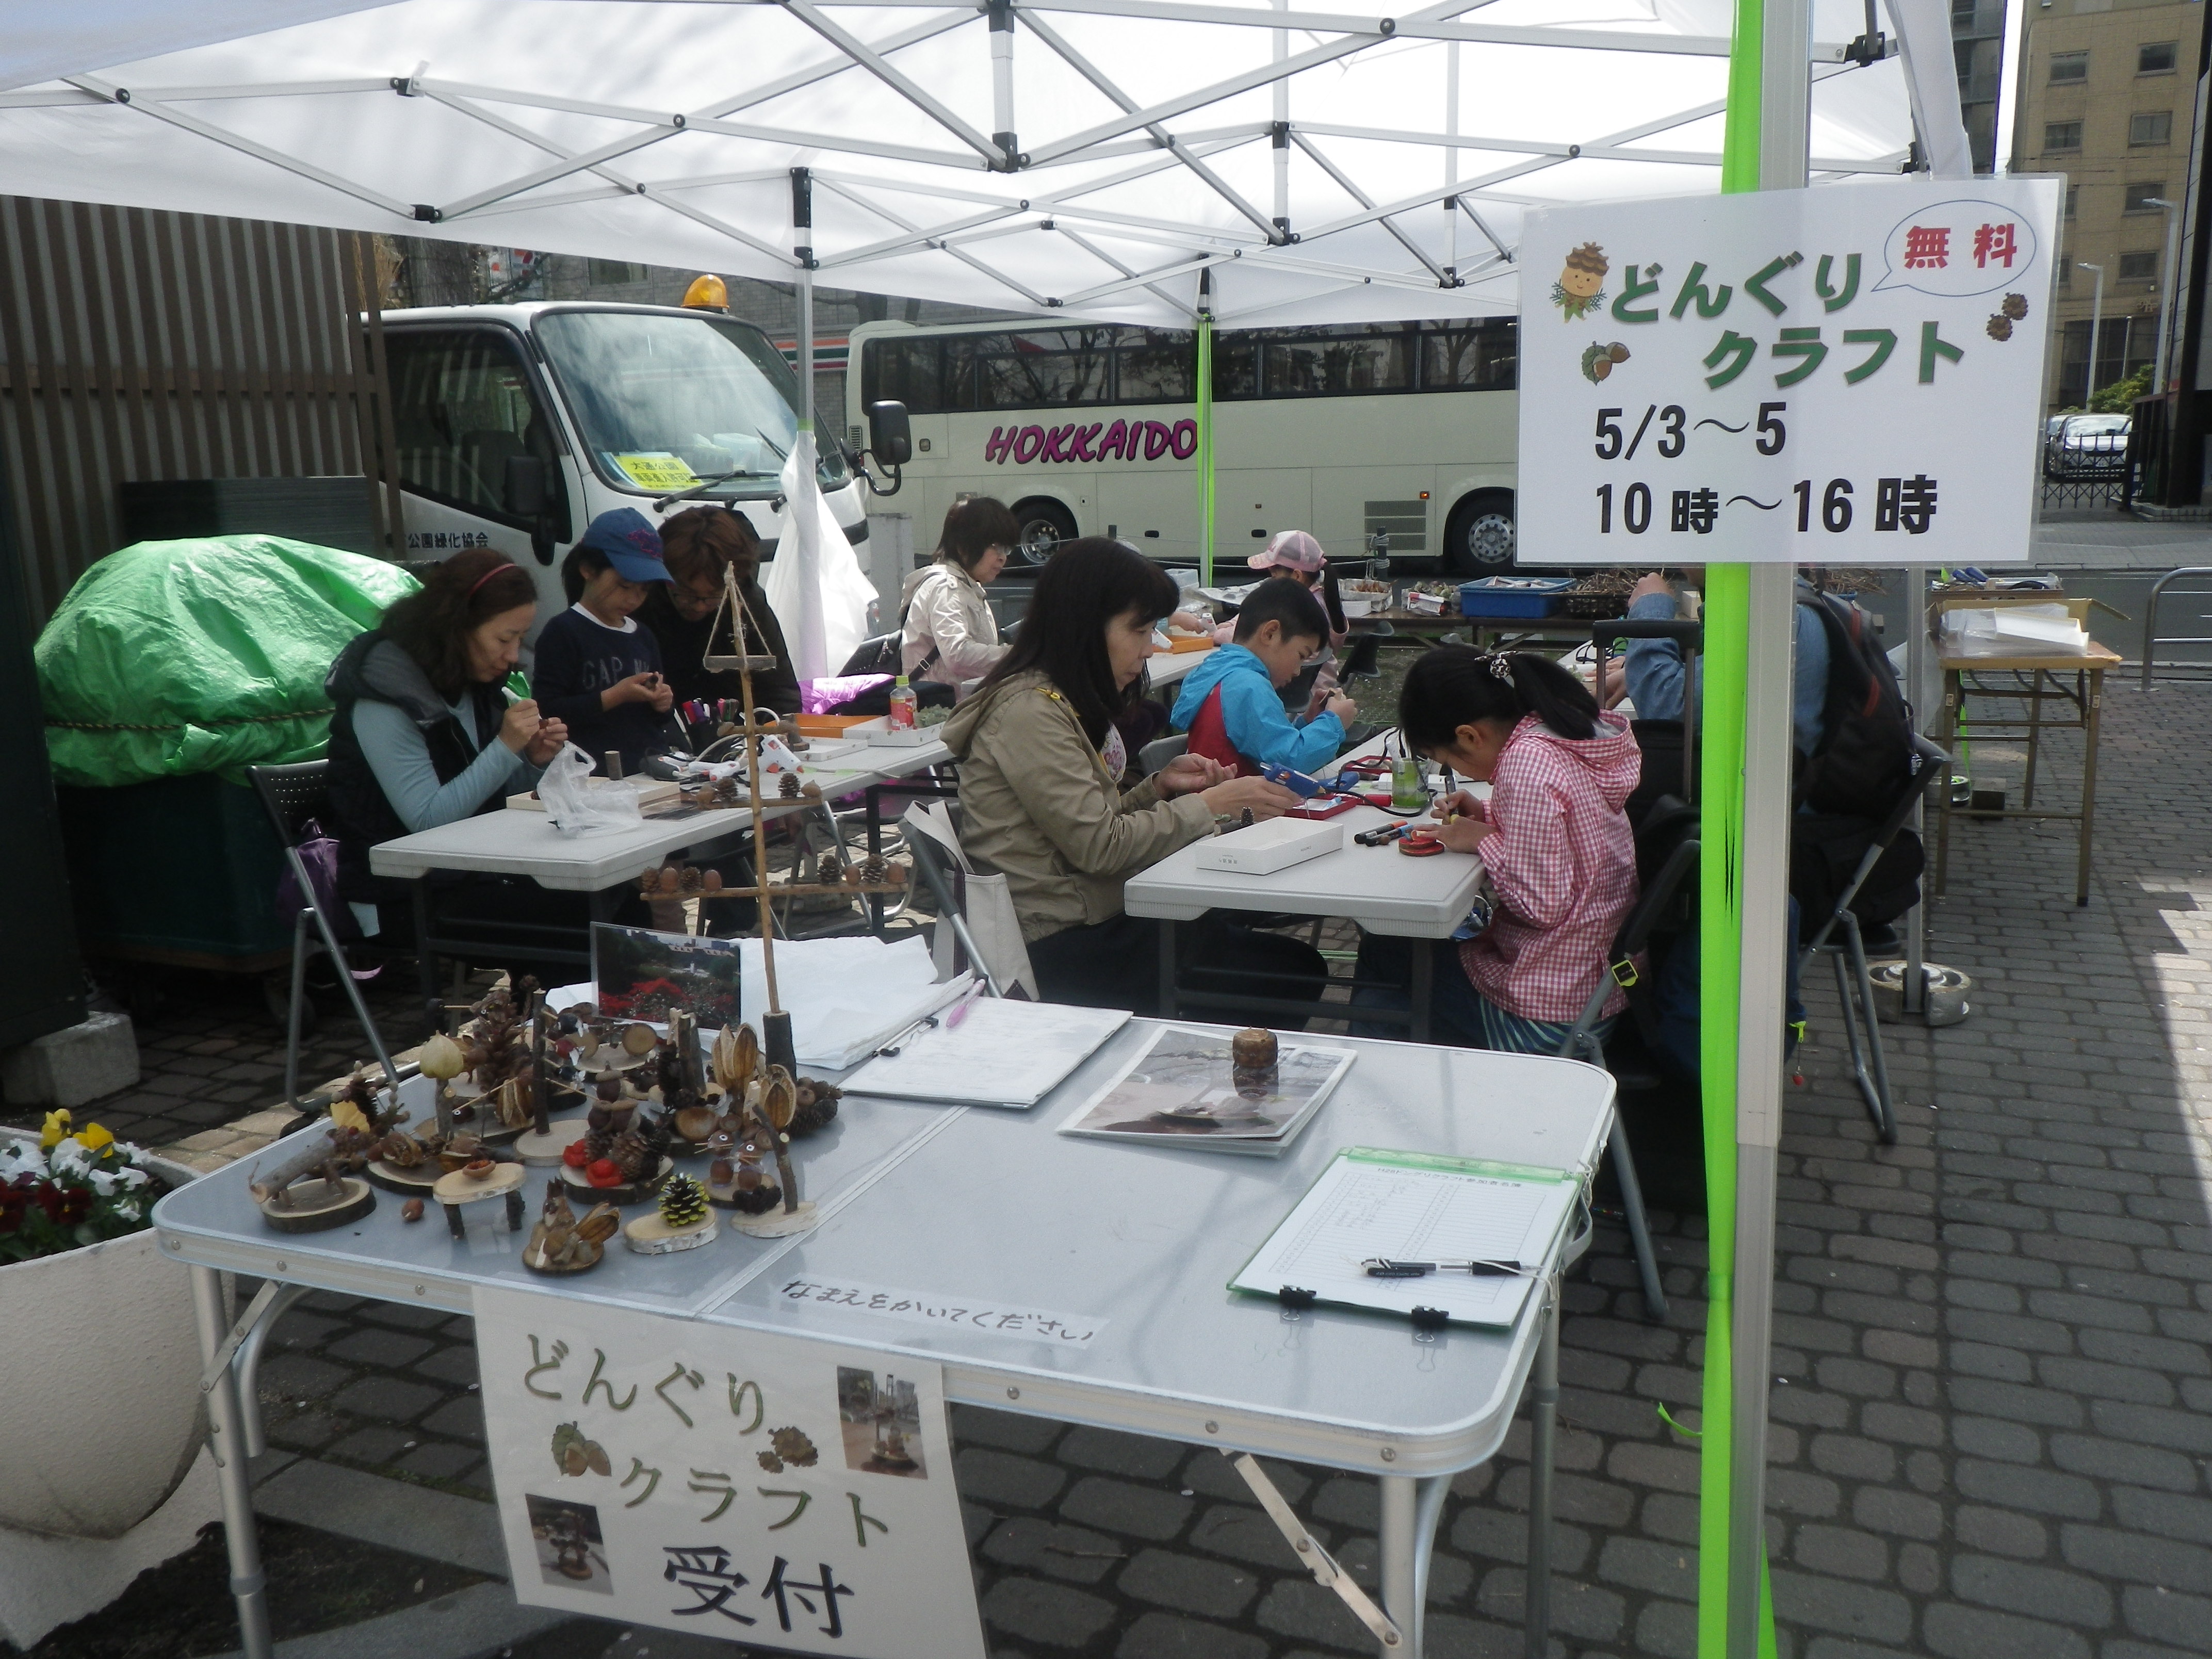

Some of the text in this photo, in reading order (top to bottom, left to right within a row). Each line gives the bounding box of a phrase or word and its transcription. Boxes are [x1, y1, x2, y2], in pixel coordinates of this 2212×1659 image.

[1905, 224, 2018, 269] 無料
[1611, 250, 1863, 325] どんぐり
[1701, 320, 1965, 391] クラフト
[985, 418, 1198, 465] HOKKAIDO
[582, 656, 623, 690] GAP
[780, 1280, 1093, 1341] なまえをかいてください
[524, 1333, 765, 1435] どんぐり
[620, 1456, 889, 1547] クラフト
[661, 1545, 855, 1639] 受付
